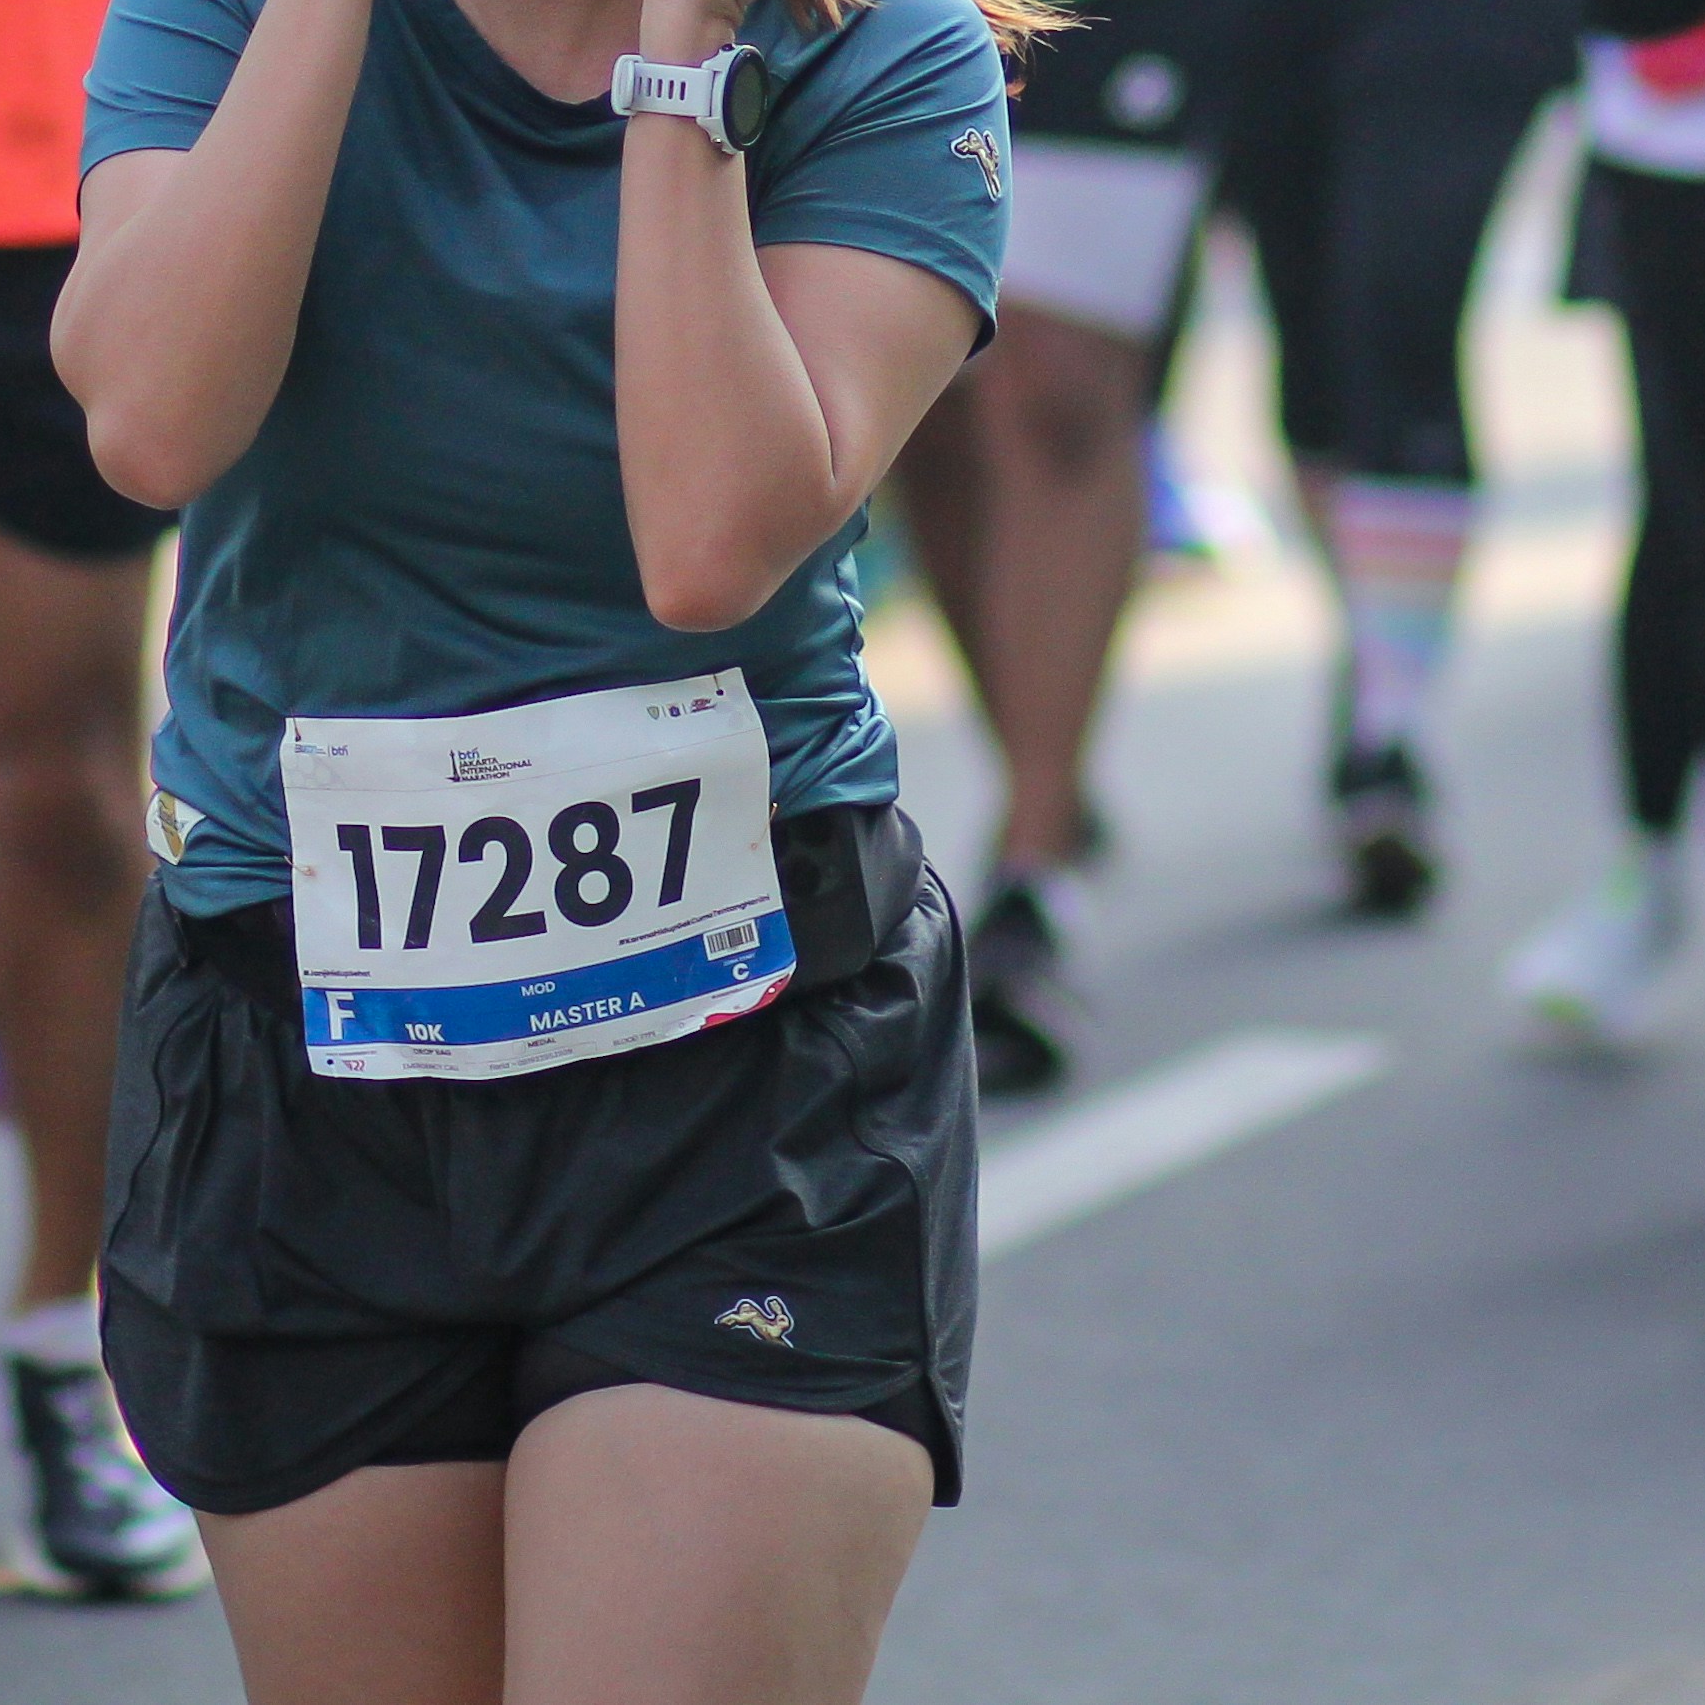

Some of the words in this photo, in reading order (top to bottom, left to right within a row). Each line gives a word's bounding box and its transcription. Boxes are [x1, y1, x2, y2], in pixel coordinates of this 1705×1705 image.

[459, 757, 500, 768] JAKARTA
[459, 759, 533, 775] INTERNATIONAL
[462, 771, 511, 782] MARATHON
[336, 777, 702, 950] 17287
[732, 962, 750, 981] C
[521, 981, 557, 997] MOD
[325, 991, 356, 1041] F
[529, 996, 624, 1033] MASTER
[629, 991, 646, 1011] A
[405, 1023, 445, 1042] 10K
[527, 1037, 558, 1049] MEDAL
